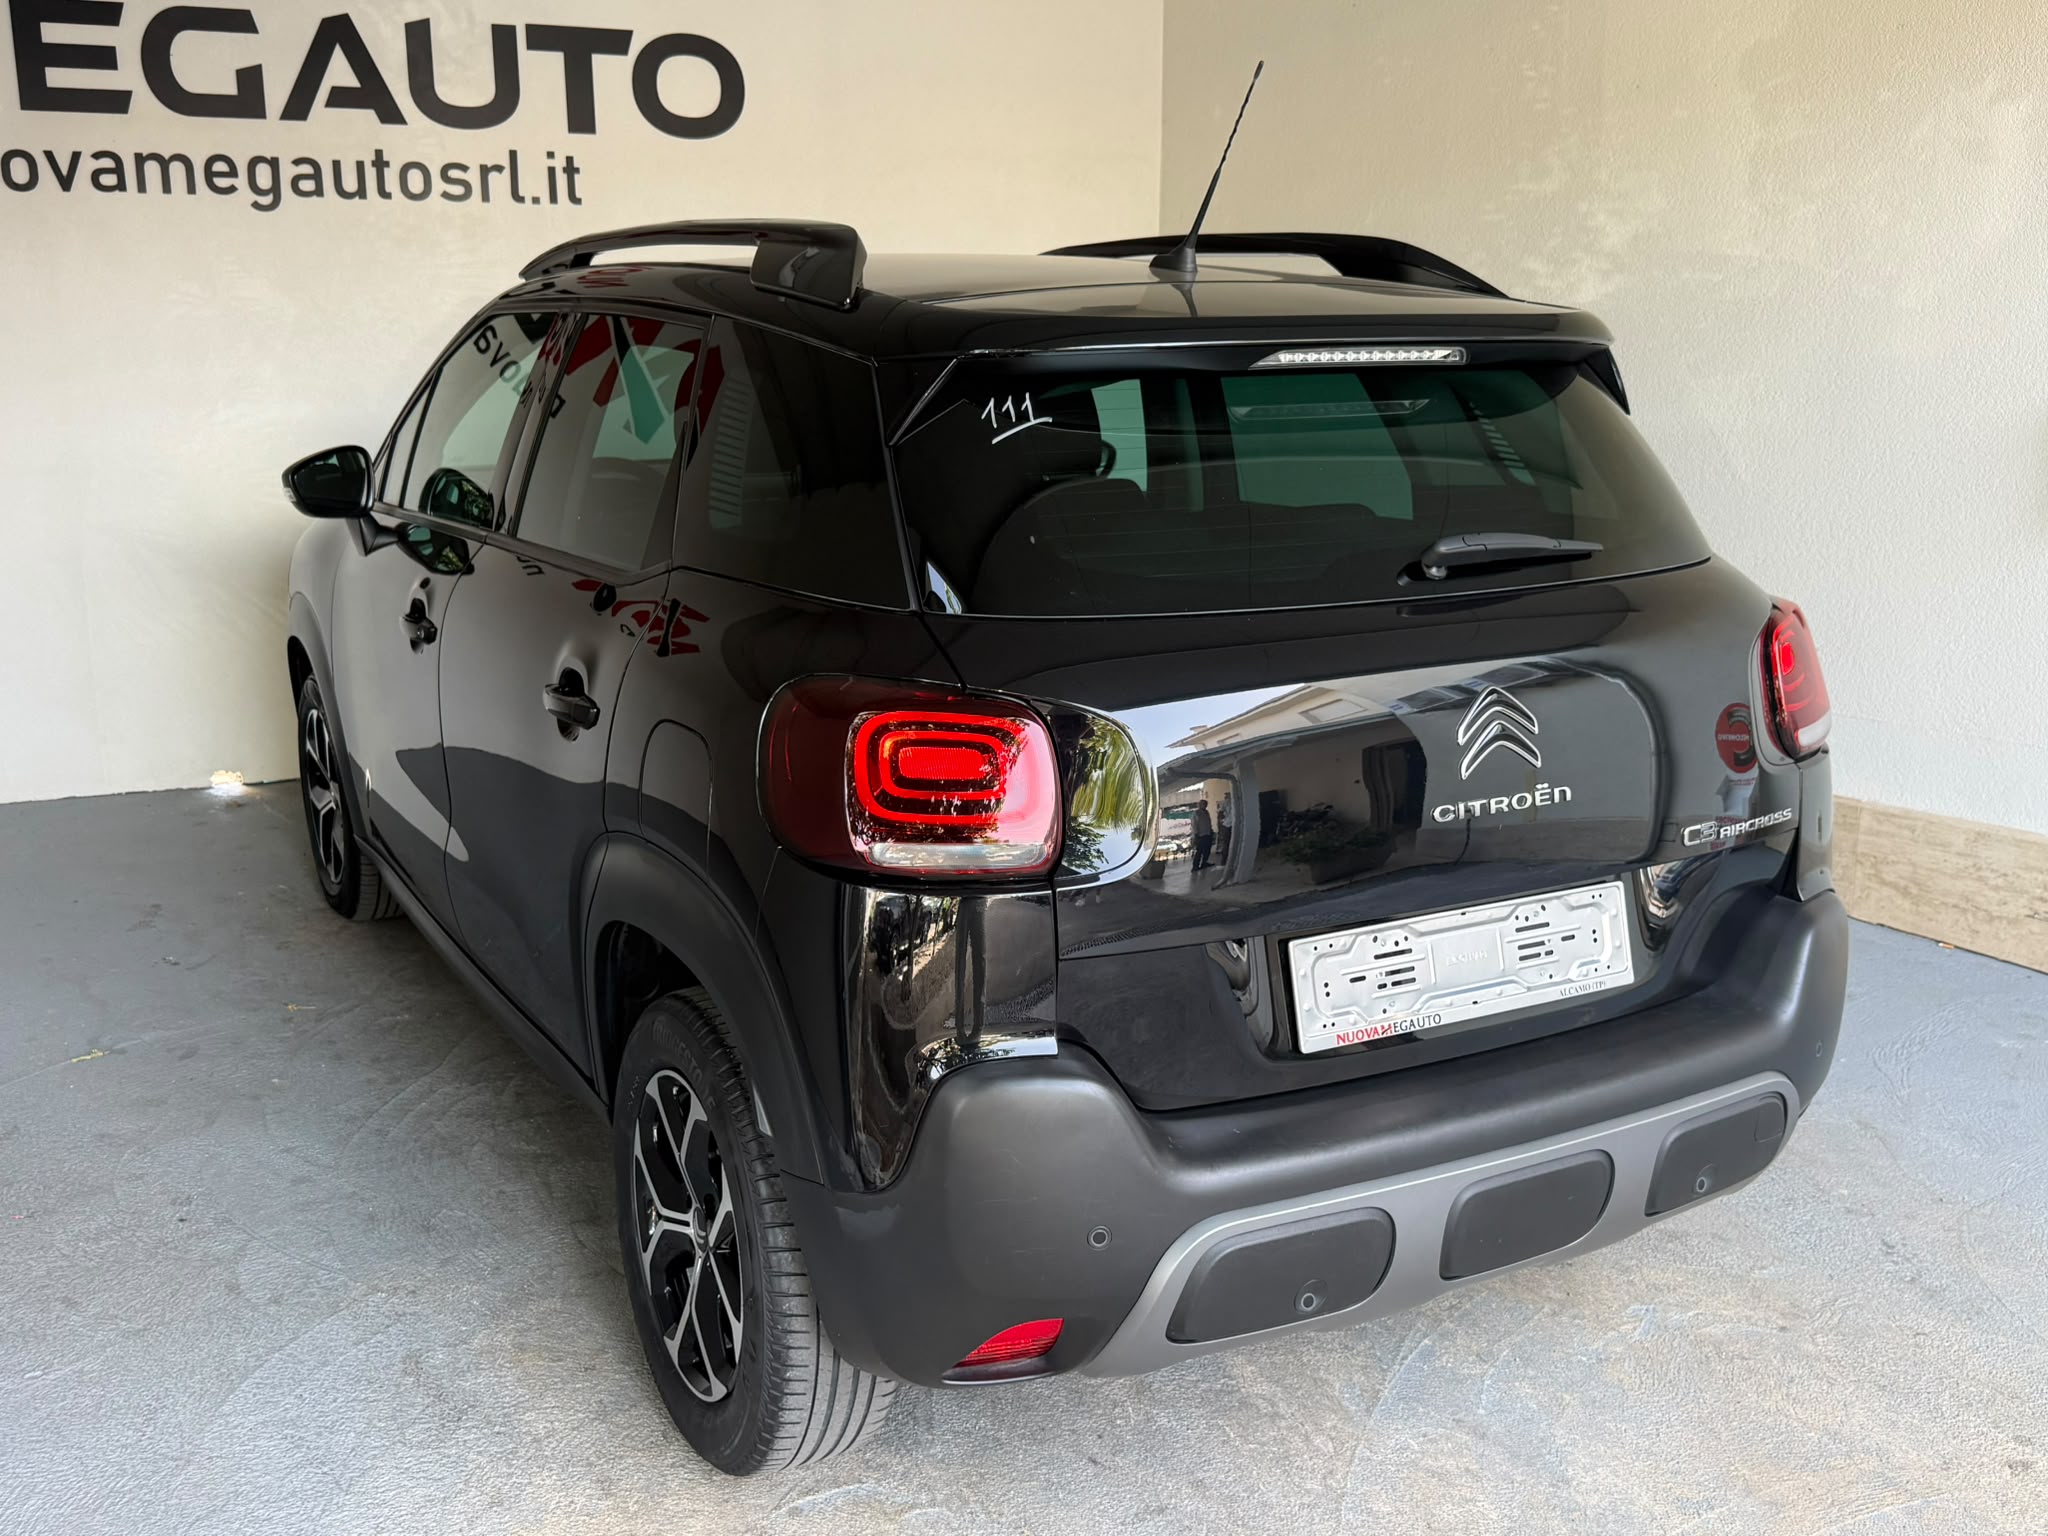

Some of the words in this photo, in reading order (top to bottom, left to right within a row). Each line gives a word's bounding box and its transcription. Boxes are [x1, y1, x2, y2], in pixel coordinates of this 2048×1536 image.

[8, 0, 746, 139] EGAUTO
[1, 148, 583, 212] ovamegautosrl.it
[981, 392, 1036, 429] 111
[1683, 821, 1719, 847] C3
[1720, 808, 1793, 838] AIRCROSS
